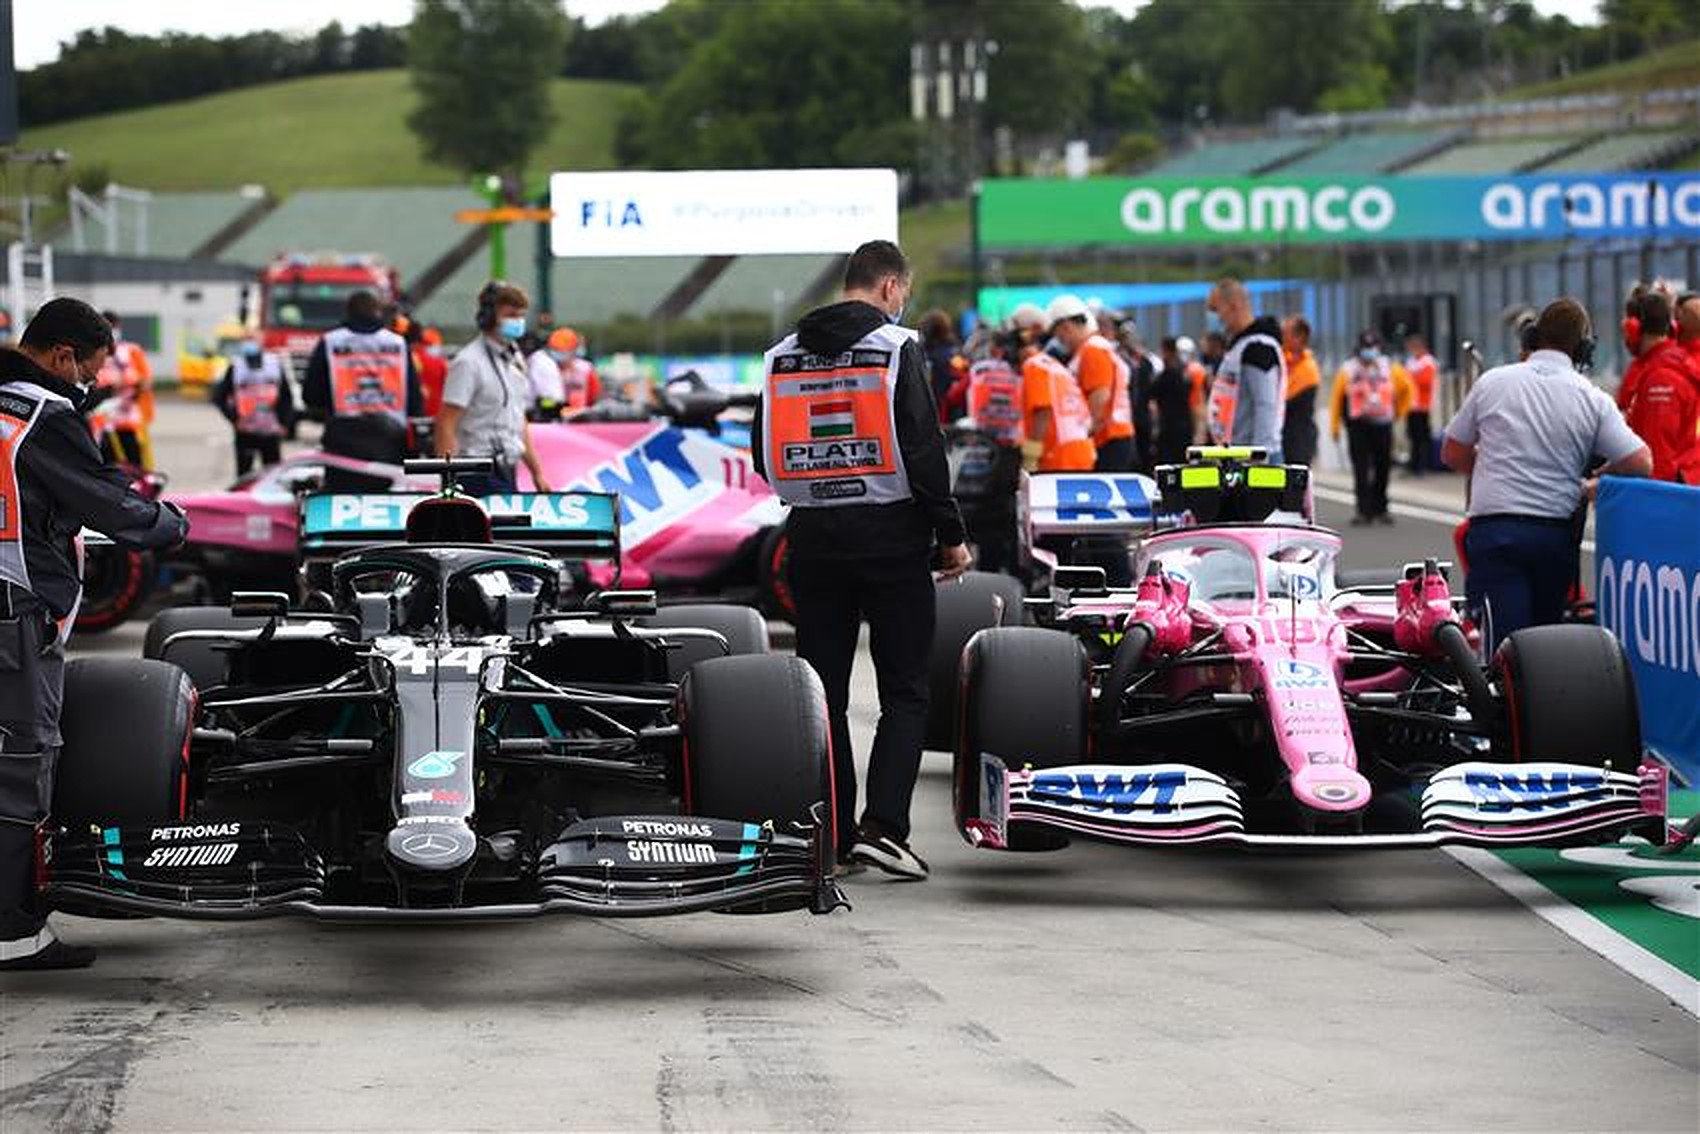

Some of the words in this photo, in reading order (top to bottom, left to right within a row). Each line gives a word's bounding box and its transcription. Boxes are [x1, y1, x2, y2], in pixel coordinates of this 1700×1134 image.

[1121, 186, 1395, 233] aramco
[786, 442, 864, 460] PLAT
[722, 457, 747, 489] 11
[330, 494, 590, 527] PETNAS
[1026, 771, 1186, 815] BWT
[151, 822, 241, 841] PETRONAS
[622, 820, 713, 837] PETRONAS
[144, 843, 239, 867] SYNTIUM
[627, 840, 717, 863] SYNTIUM
